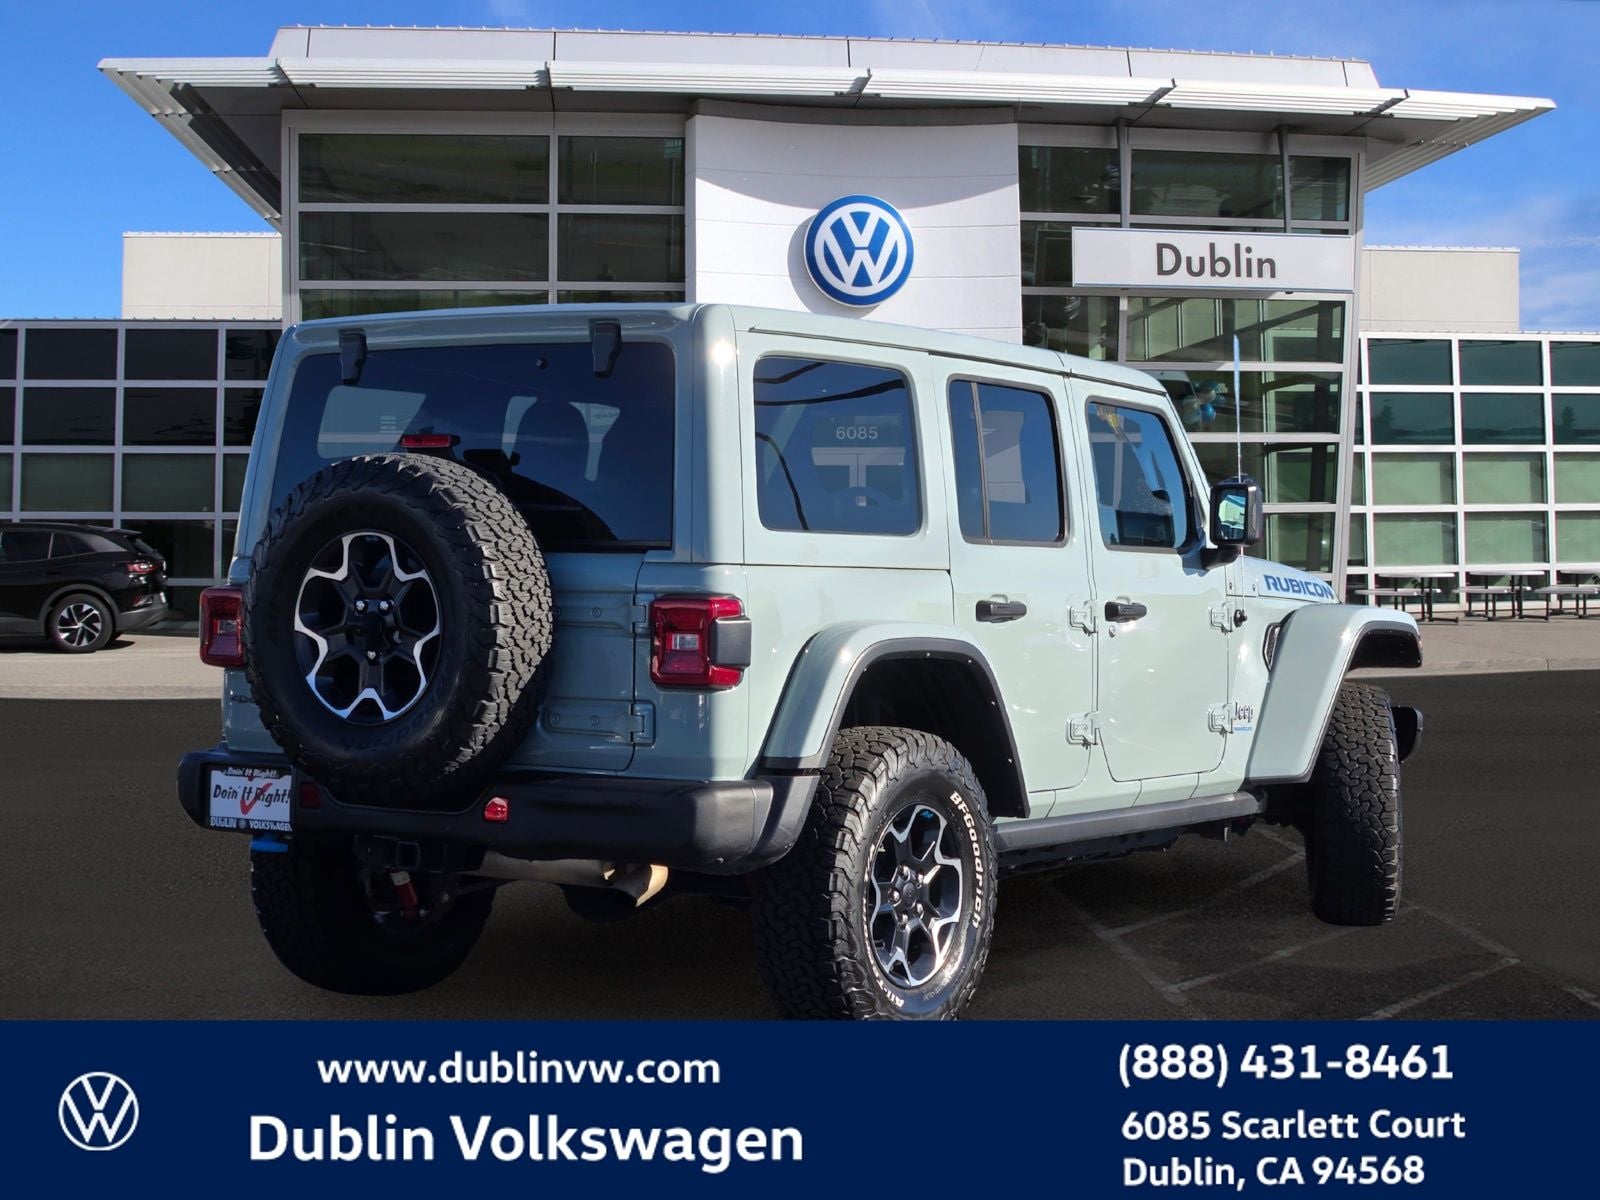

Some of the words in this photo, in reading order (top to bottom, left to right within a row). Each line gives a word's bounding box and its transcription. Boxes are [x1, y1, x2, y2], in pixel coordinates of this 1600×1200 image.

[1156, 242, 1277, 279] Dublin
[836, 426, 878, 440] 6085
[1263, 574, 1335, 600] RUBICON
[213, 784, 240, 800] Doin'
[241, 786, 253, 801] It
[255, 787, 291, 808] Right!
[210, 816, 237, 829] DUBLIN
[249, 820, 293, 832] VOLKSWAGEN
[950, 790, 985, 929] BFGoodrich
